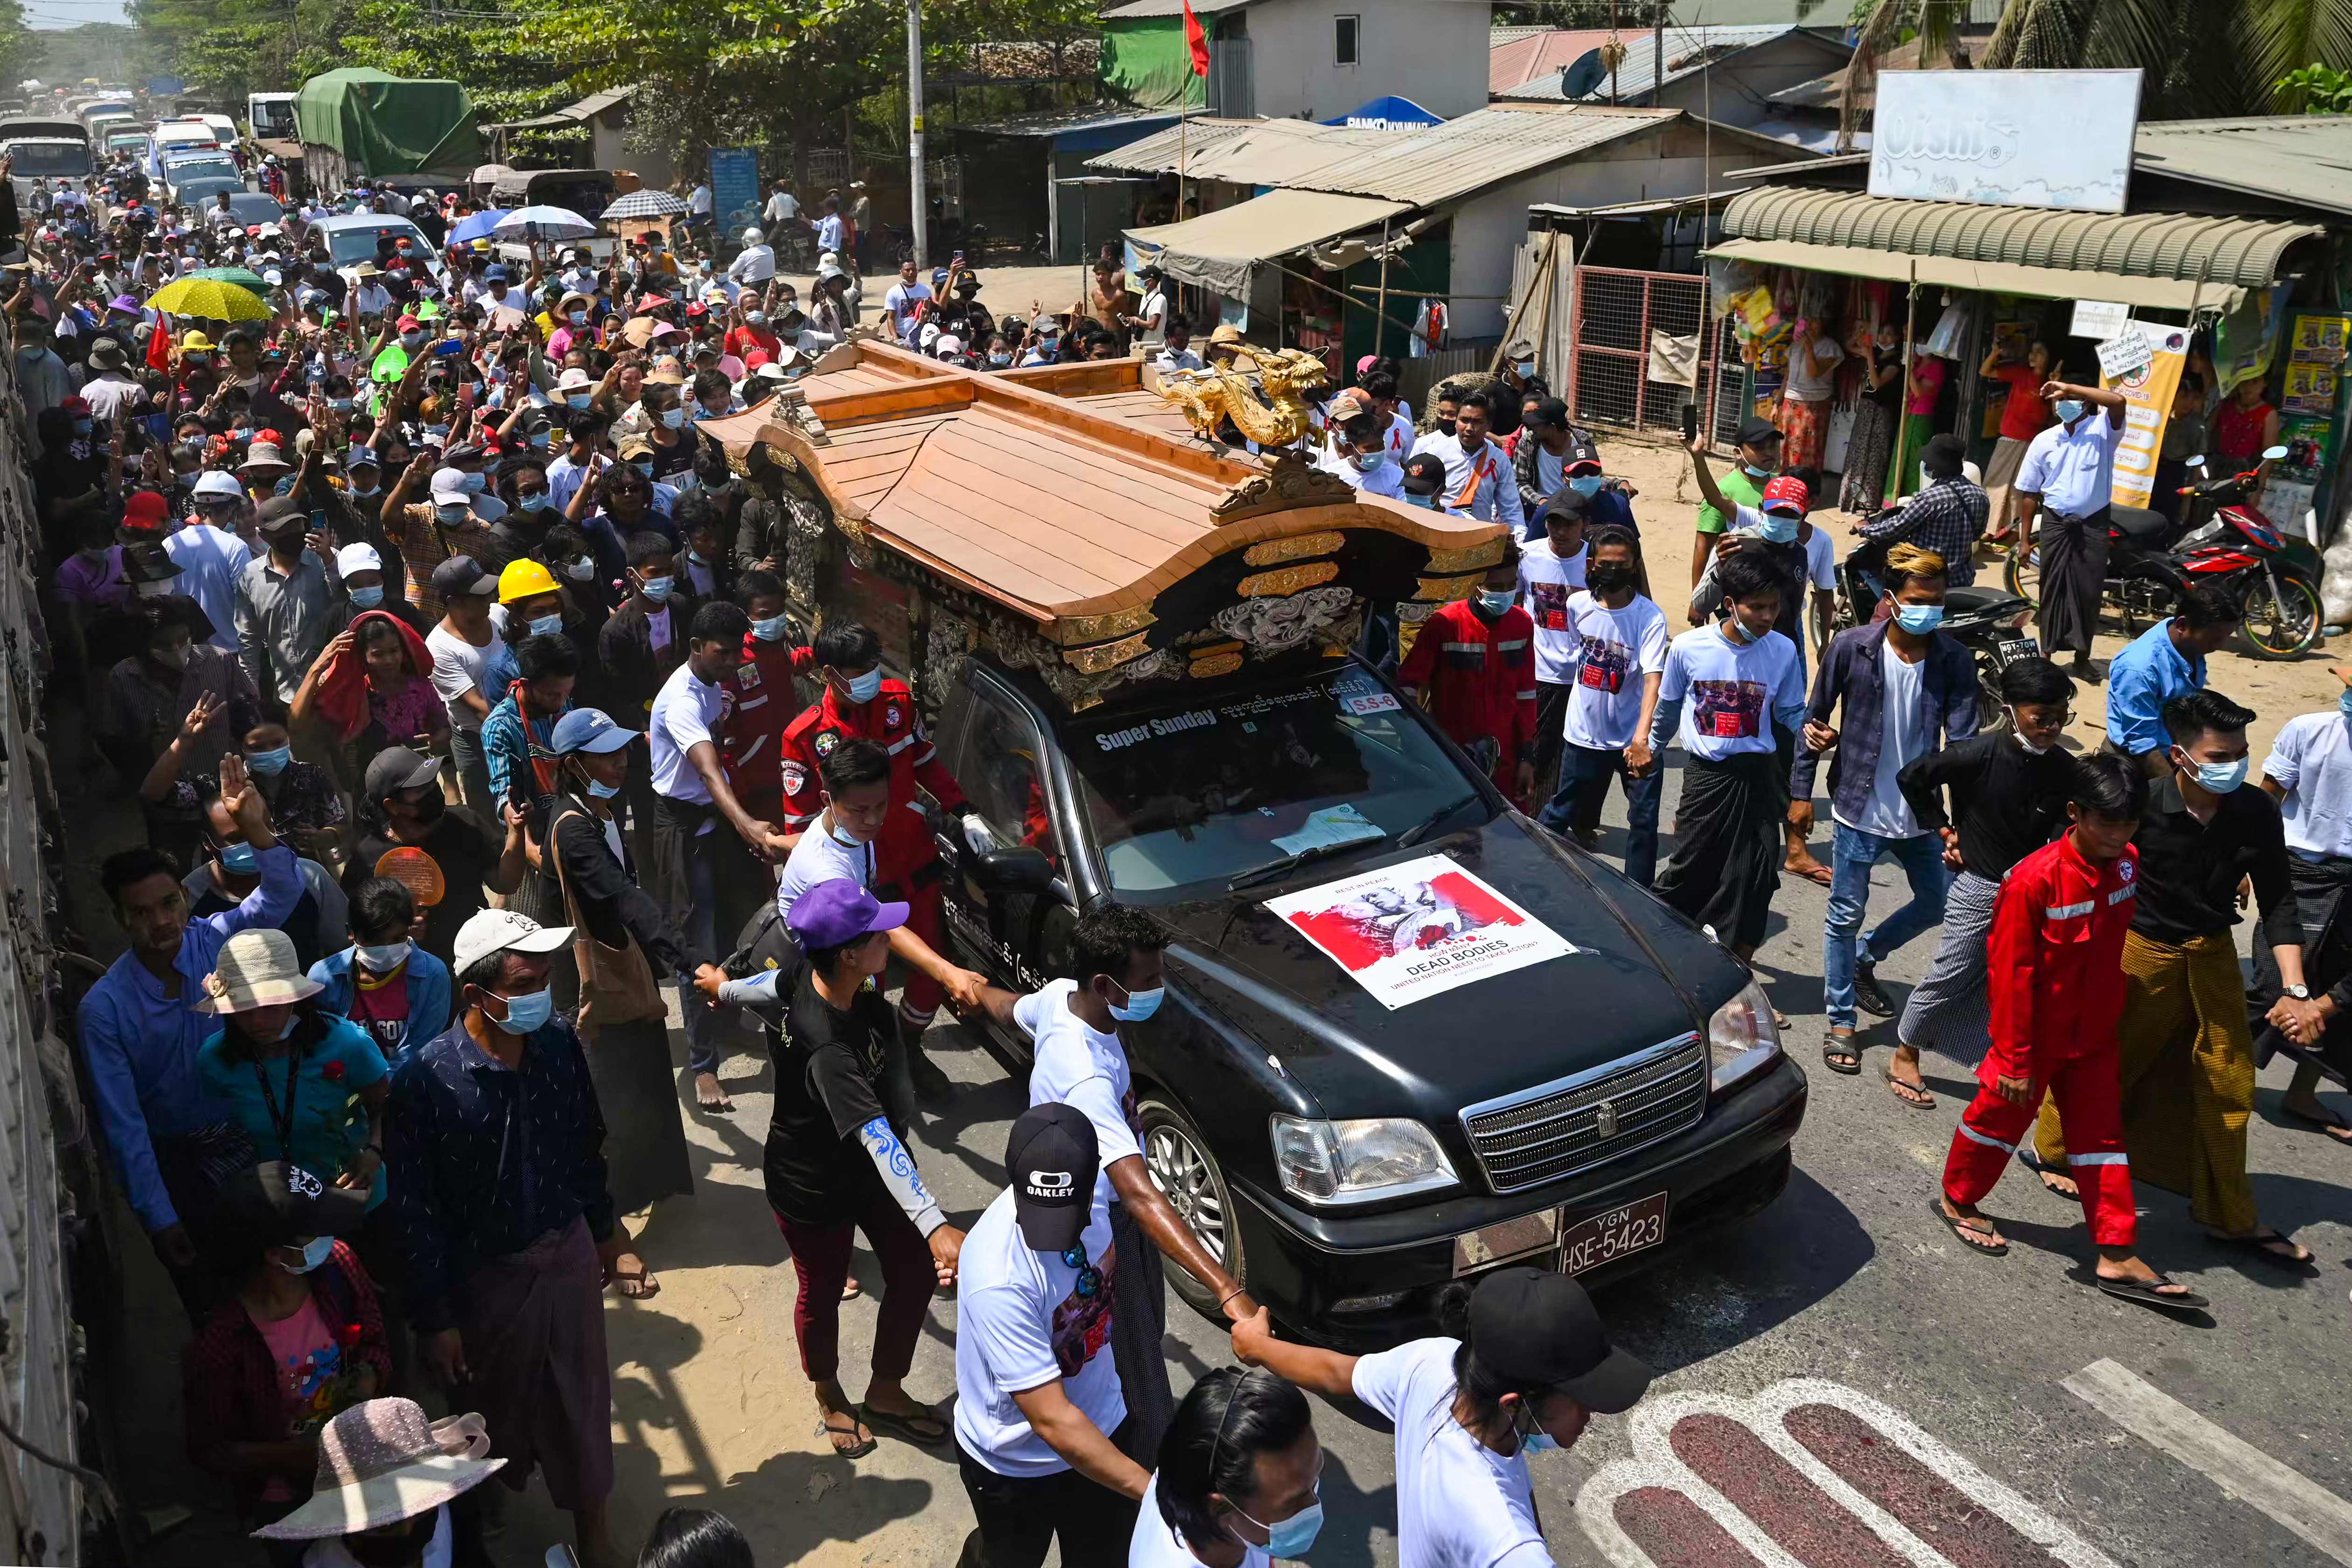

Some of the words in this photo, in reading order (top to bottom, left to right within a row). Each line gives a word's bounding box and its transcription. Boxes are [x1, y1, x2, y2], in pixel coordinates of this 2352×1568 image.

[1347, 117, 1387, 131] PANKO
[1096, 724, 1152, 751] Super
[1150, 709, 1217, 735] Sunday
[1365, 877, 1391, 885] PEACE
[1406, 957, 1450, 975] DEAD
[1451, 940, 1509, 961] BODIES
[1428, 947, 1448, 959] HOW
[1448, 943, 1471, 953] MANY
[1391, 977, 1421, 989] UNITED
[1421, 967, 1451, 980] NATION
[1452, 960, 1473, 970] NEED
[1486, 950, 1506, 960] TAKE
[1508, 941, 1539, 953] ACTION?
[1027, 1186, 1074, 1197] OAKLEY
[1597, 1209, 1629, 1230] YGN
[1563, 1215, 1660, 1273] HSE-5423
